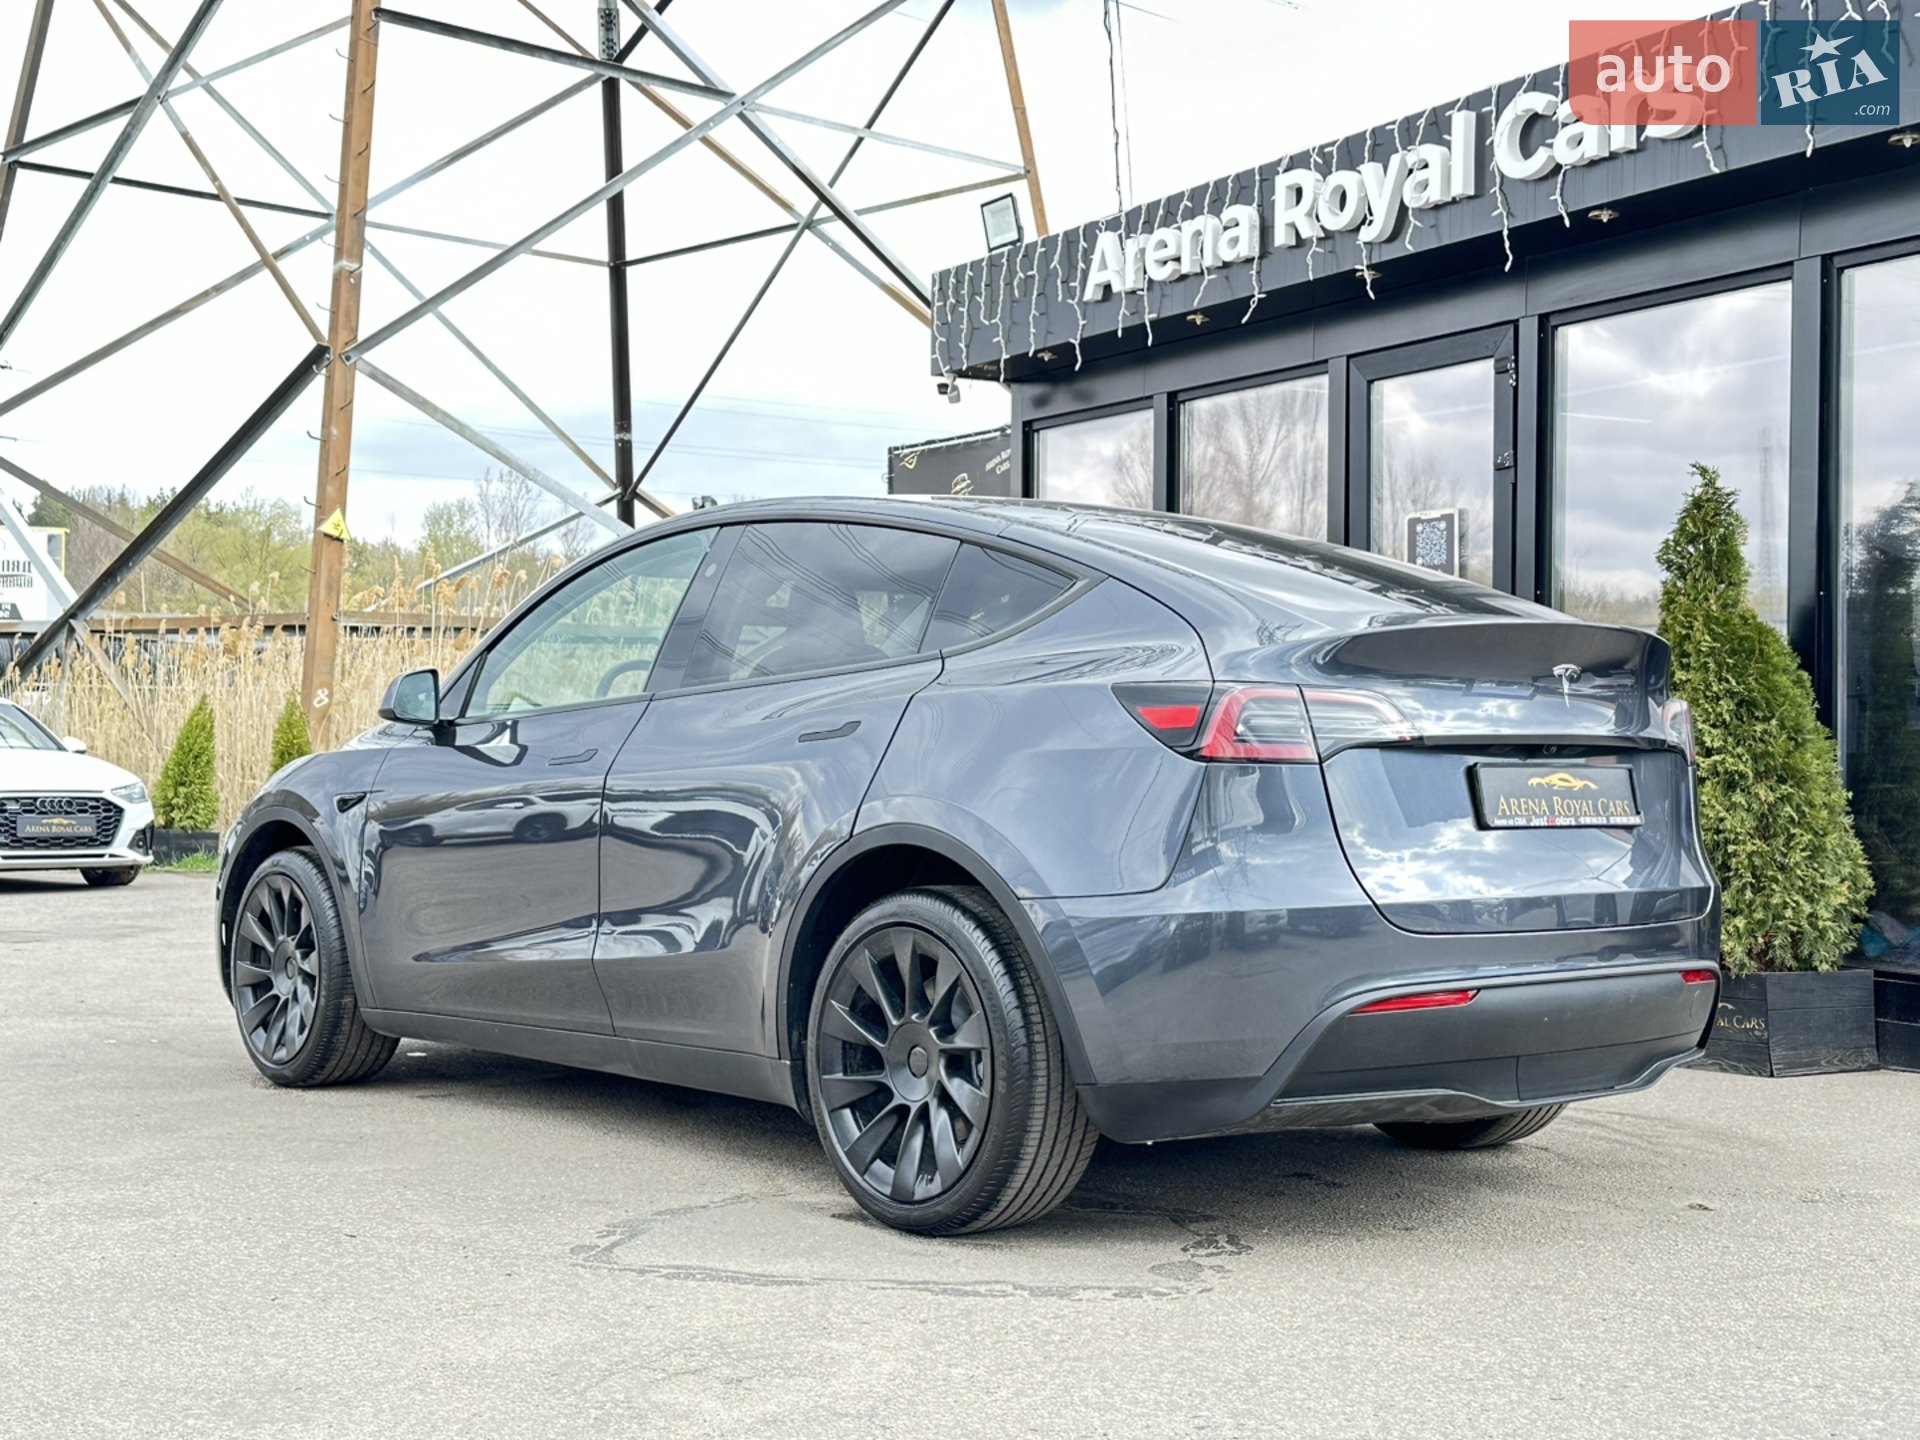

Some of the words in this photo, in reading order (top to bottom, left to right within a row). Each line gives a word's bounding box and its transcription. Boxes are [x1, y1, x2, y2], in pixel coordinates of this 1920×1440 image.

[1083, 203, 1262, 302] Arena
[1274, 110, 1477, 248] Royal
[1493, 65, 1703, 182] Cars
[1498, 795, 1549, 815] ARENA
[1553, 796, 1597, 816] ROYAL
[1598, 798, 1631, 816] CARS
[24, 824, 50, 833] ARENA
[52, 824, 73, 833] ROYAL
[74, 824, 93, 833] CARS
[1732, 1015, 1765, 1029] CARS
